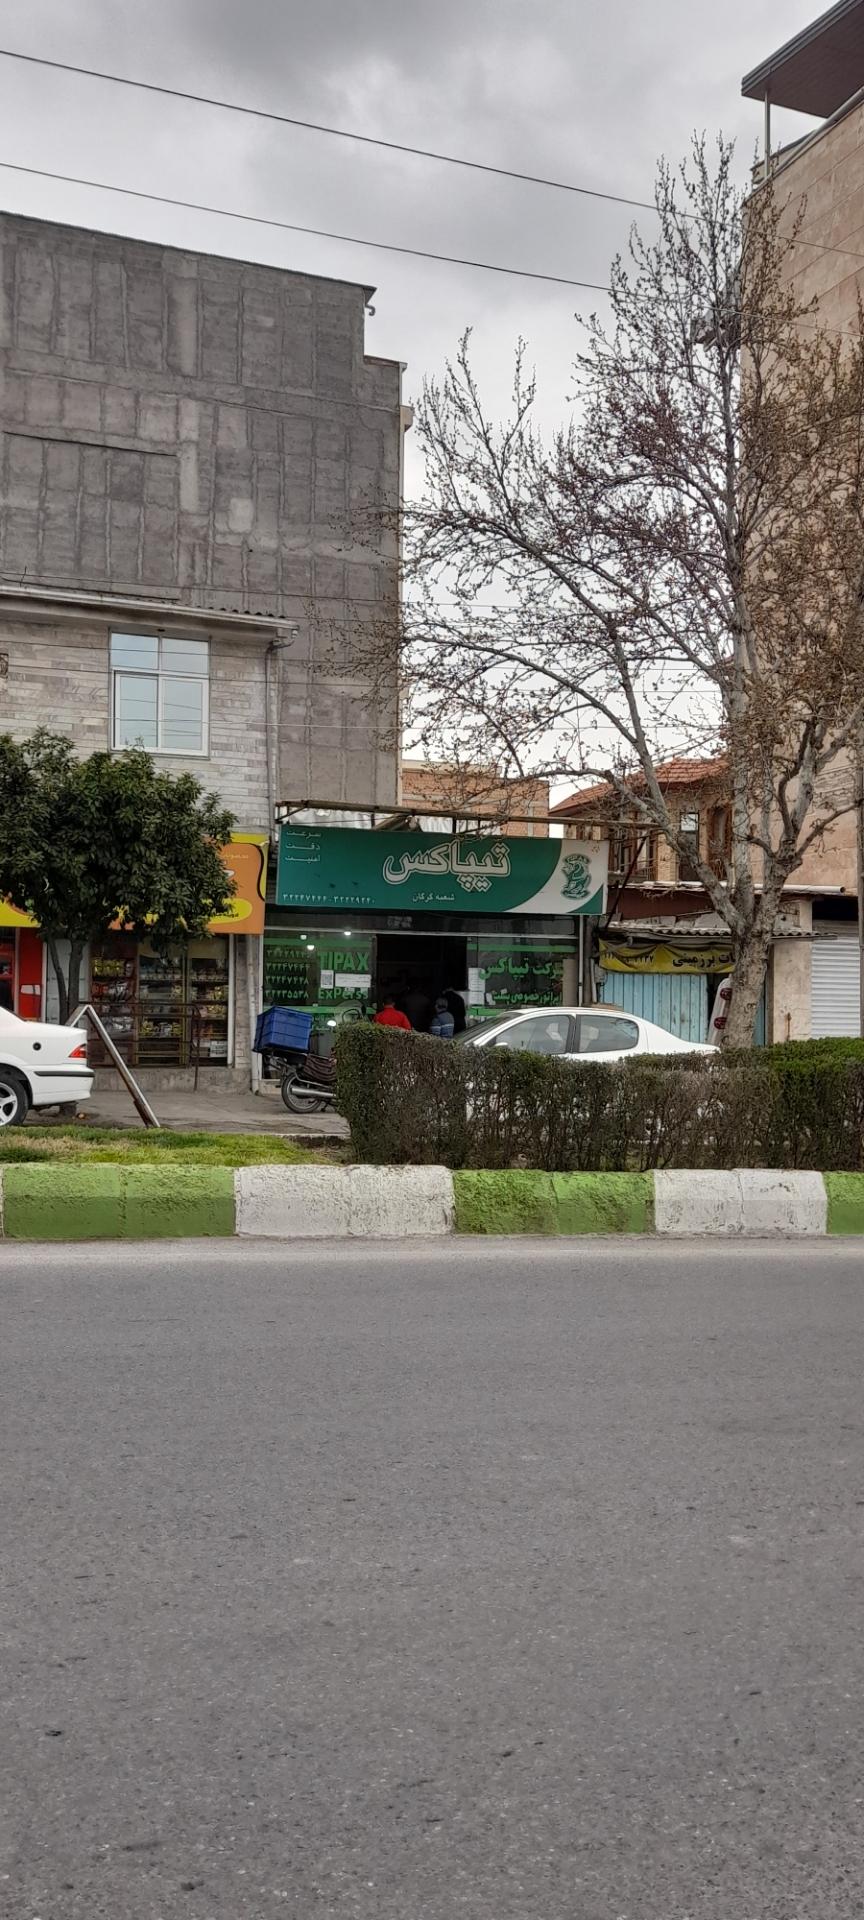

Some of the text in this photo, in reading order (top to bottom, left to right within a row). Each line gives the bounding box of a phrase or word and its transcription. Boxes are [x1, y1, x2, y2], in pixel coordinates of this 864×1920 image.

[382, 839, 510, 892] تیپاکس
[435, 892, 455, 901] شعبه
[318, 951, 369, 971] TIPAX
[479, 957, 530, 981] تیپاکس
